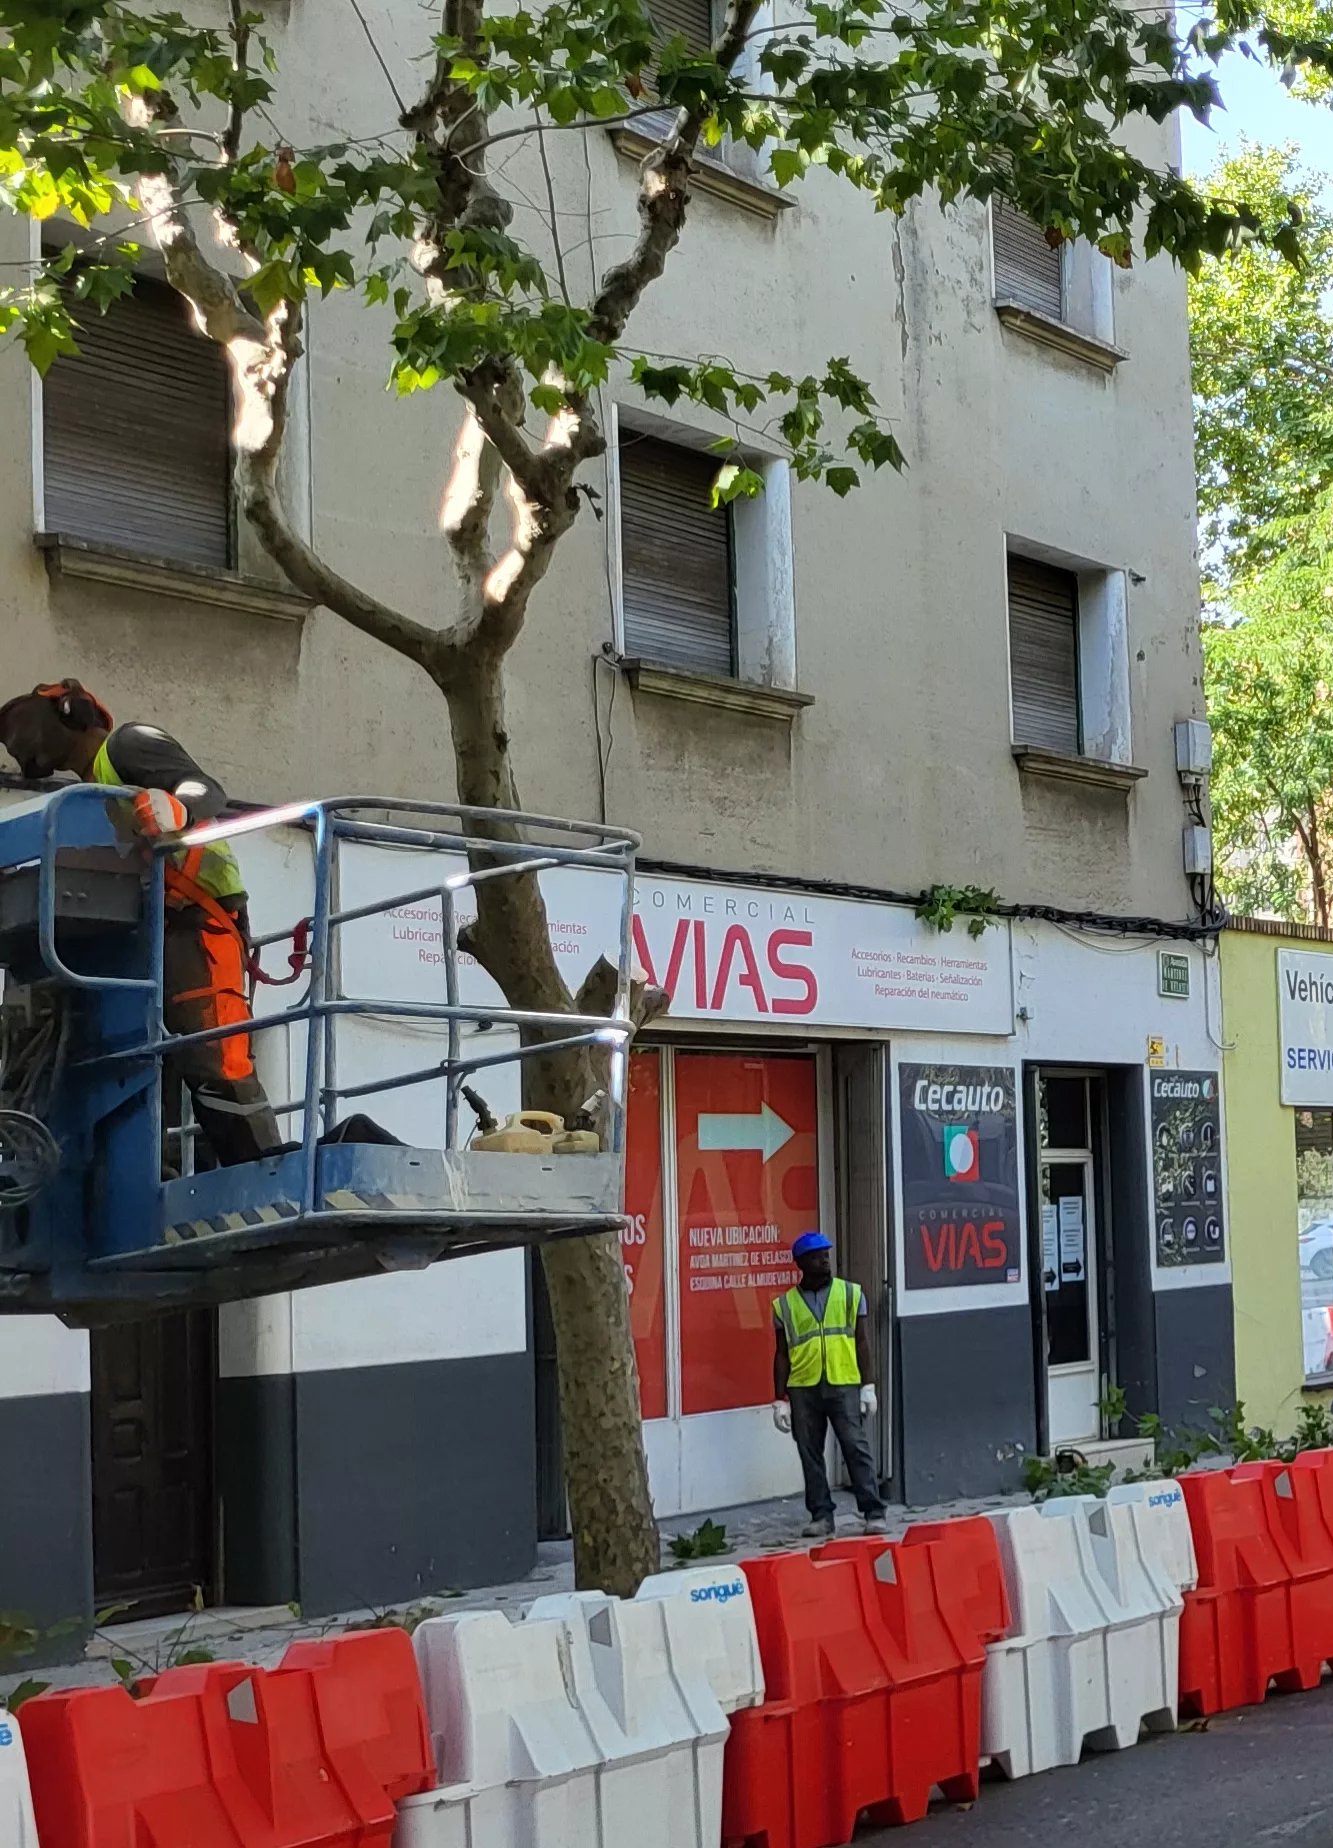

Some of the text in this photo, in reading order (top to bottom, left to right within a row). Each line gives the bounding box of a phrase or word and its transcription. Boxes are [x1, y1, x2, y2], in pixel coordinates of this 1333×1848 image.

[392, 926, 442, 942] Lubrican
[851, 947, 988, 971] Accesorios Recambios Herramientas
[857, 966, 902, 980] Lubricantes
[939, 972, 983, 986] Señalización
[874, 983, 969, 1002] Reparación del neumático
[914, 1079, 1004, 1112] Cecauto
[1153, 1077, 1200, 1098] Cecauto
[918, 1208, 1005, 1221] COMERCIAL
[689, 1226, 723, 1247] NUEVA
[920, 1221, 1008, 1273] VIAS
[750, 1251, 761, 1266] DE
[723, 1273, 747, 1289] CALLE
